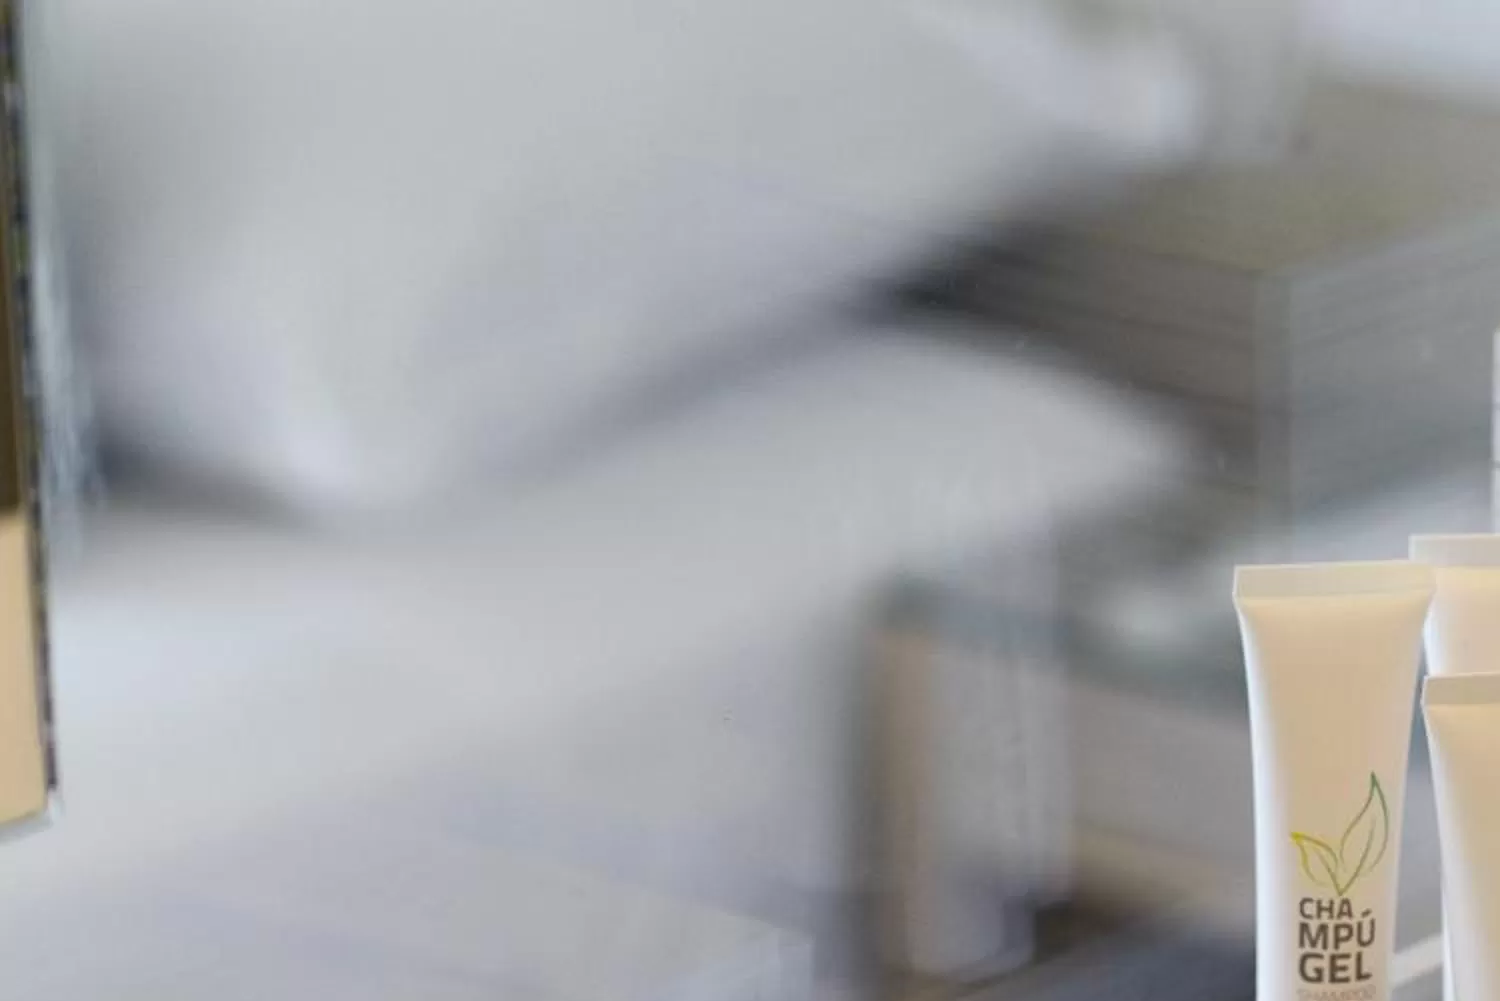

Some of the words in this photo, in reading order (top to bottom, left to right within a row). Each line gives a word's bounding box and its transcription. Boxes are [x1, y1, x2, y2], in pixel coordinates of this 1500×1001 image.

[1299, 897, 1353, 920] CHA
[1298, 908, 1375, 949] MPÚ
[1299, 951, 1372, 983] GEL
